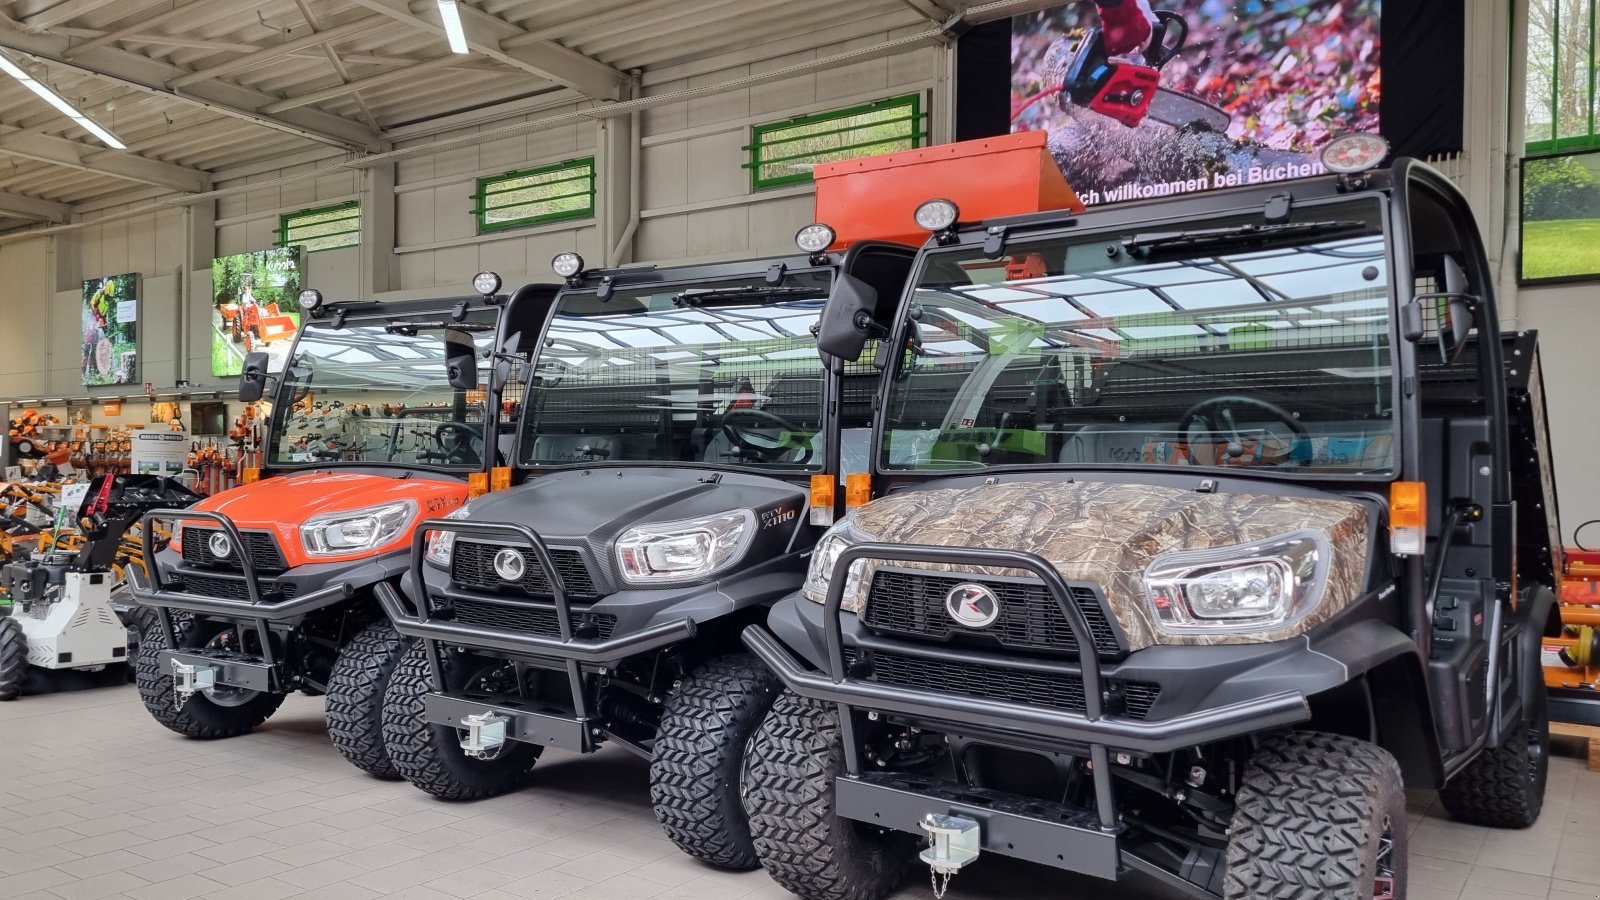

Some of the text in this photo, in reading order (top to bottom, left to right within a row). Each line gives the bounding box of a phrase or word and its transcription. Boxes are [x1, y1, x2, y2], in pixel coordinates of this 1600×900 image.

[1076, 162, 1324, 205] ich willkommen bei Buchen
[266, 258, 296, 271] Kubota
[426, 496, 446, 506] RTV
[761, 506, 782, 520] RTV
[764, 510, 796, 530] X1110
